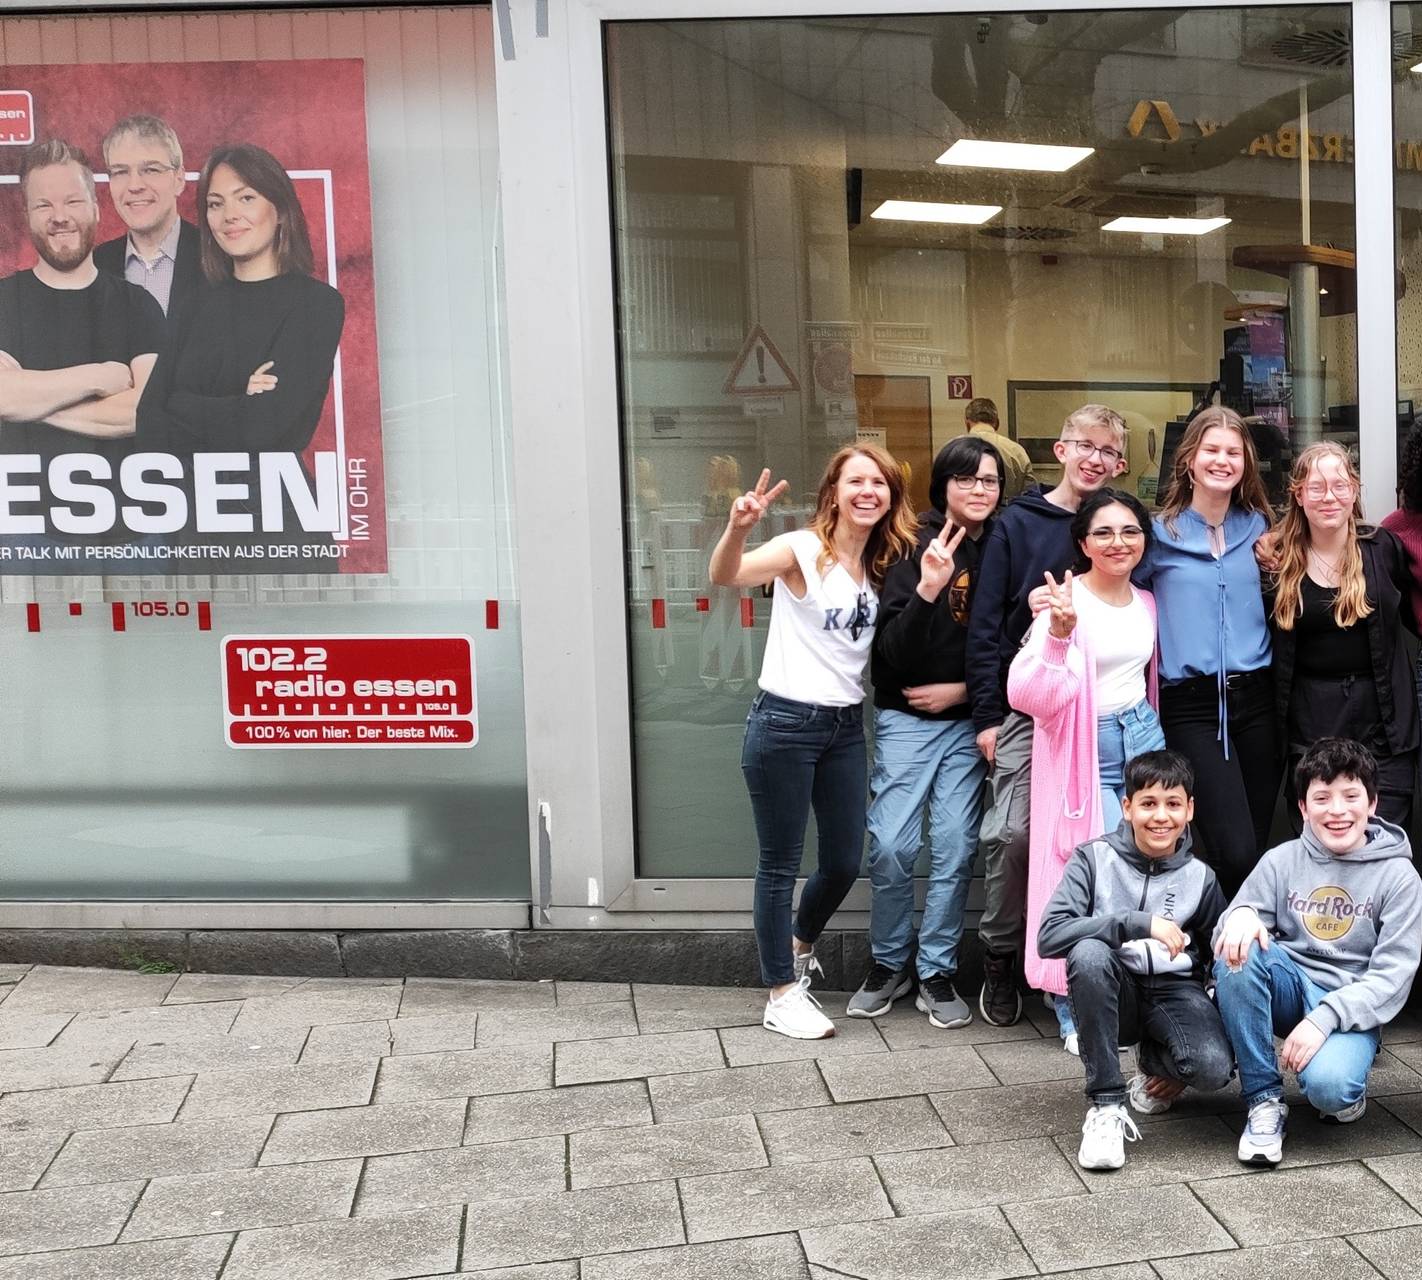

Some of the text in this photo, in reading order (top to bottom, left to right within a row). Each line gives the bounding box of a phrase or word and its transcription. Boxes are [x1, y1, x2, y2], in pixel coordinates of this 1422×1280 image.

[0, 451, 340, 535] ESSEN
[348, 457, 370, 541] IM OHR
[14, 546, 52, 560] TALK
[54, 546, 82, 560] MIT
[85, 543, 230, 560] PERSÖNLICHKEITEN
[234, 544, 265, 559] AUS
[267, 544, 299, 559] DER
[301, 544, 350, 558] STADT
[131, 601, 190, 617] 105.0
[236, 647, 328, 672] 102.2
[255, 674, 457, 698] radio essen
[245, 725, 459, 740] 100% von hier. Der beste Mix.
[1161, 892, 1176, 922] NIK
[1331, 893, 1374, 921] Rock
[1315, 922, 1340, 932] CAFE
